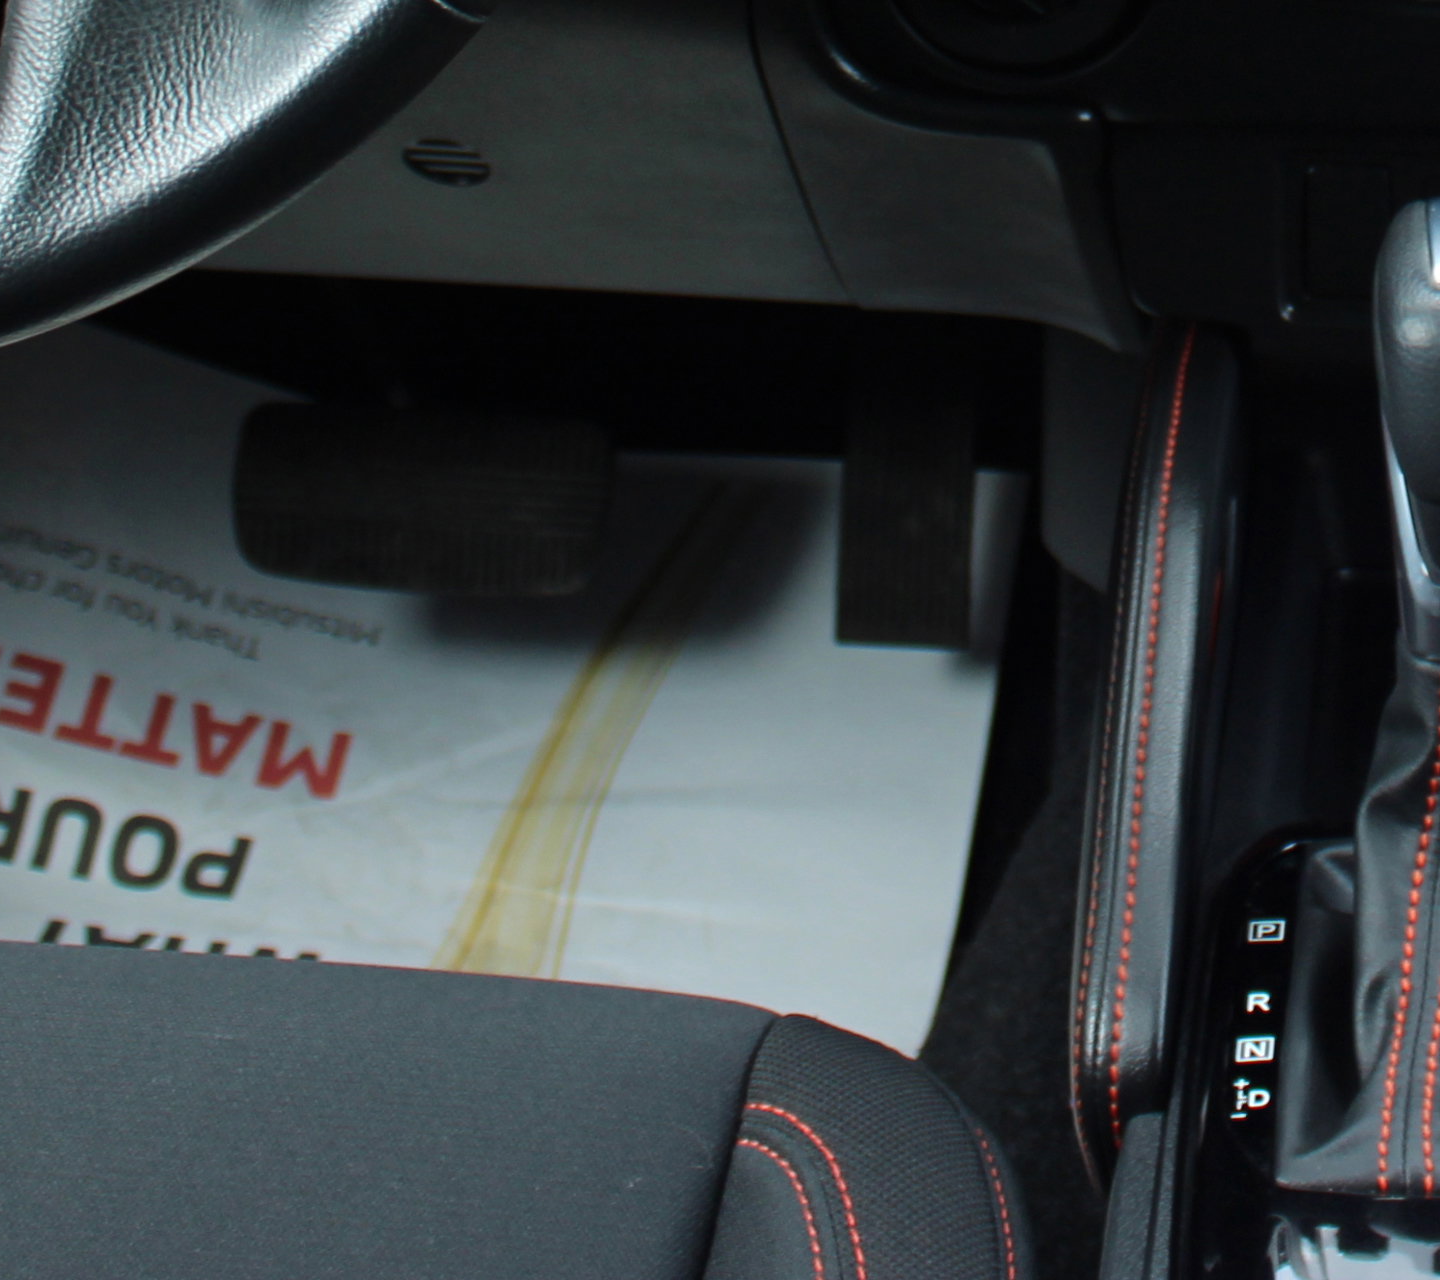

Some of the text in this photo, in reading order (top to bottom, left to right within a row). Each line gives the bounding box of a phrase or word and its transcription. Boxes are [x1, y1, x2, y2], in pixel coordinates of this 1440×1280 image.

[172, 613, 260, 662] Thank
[1246, 992, 1271, 1013] R
[1247, 1089, 1271, 1108] D
